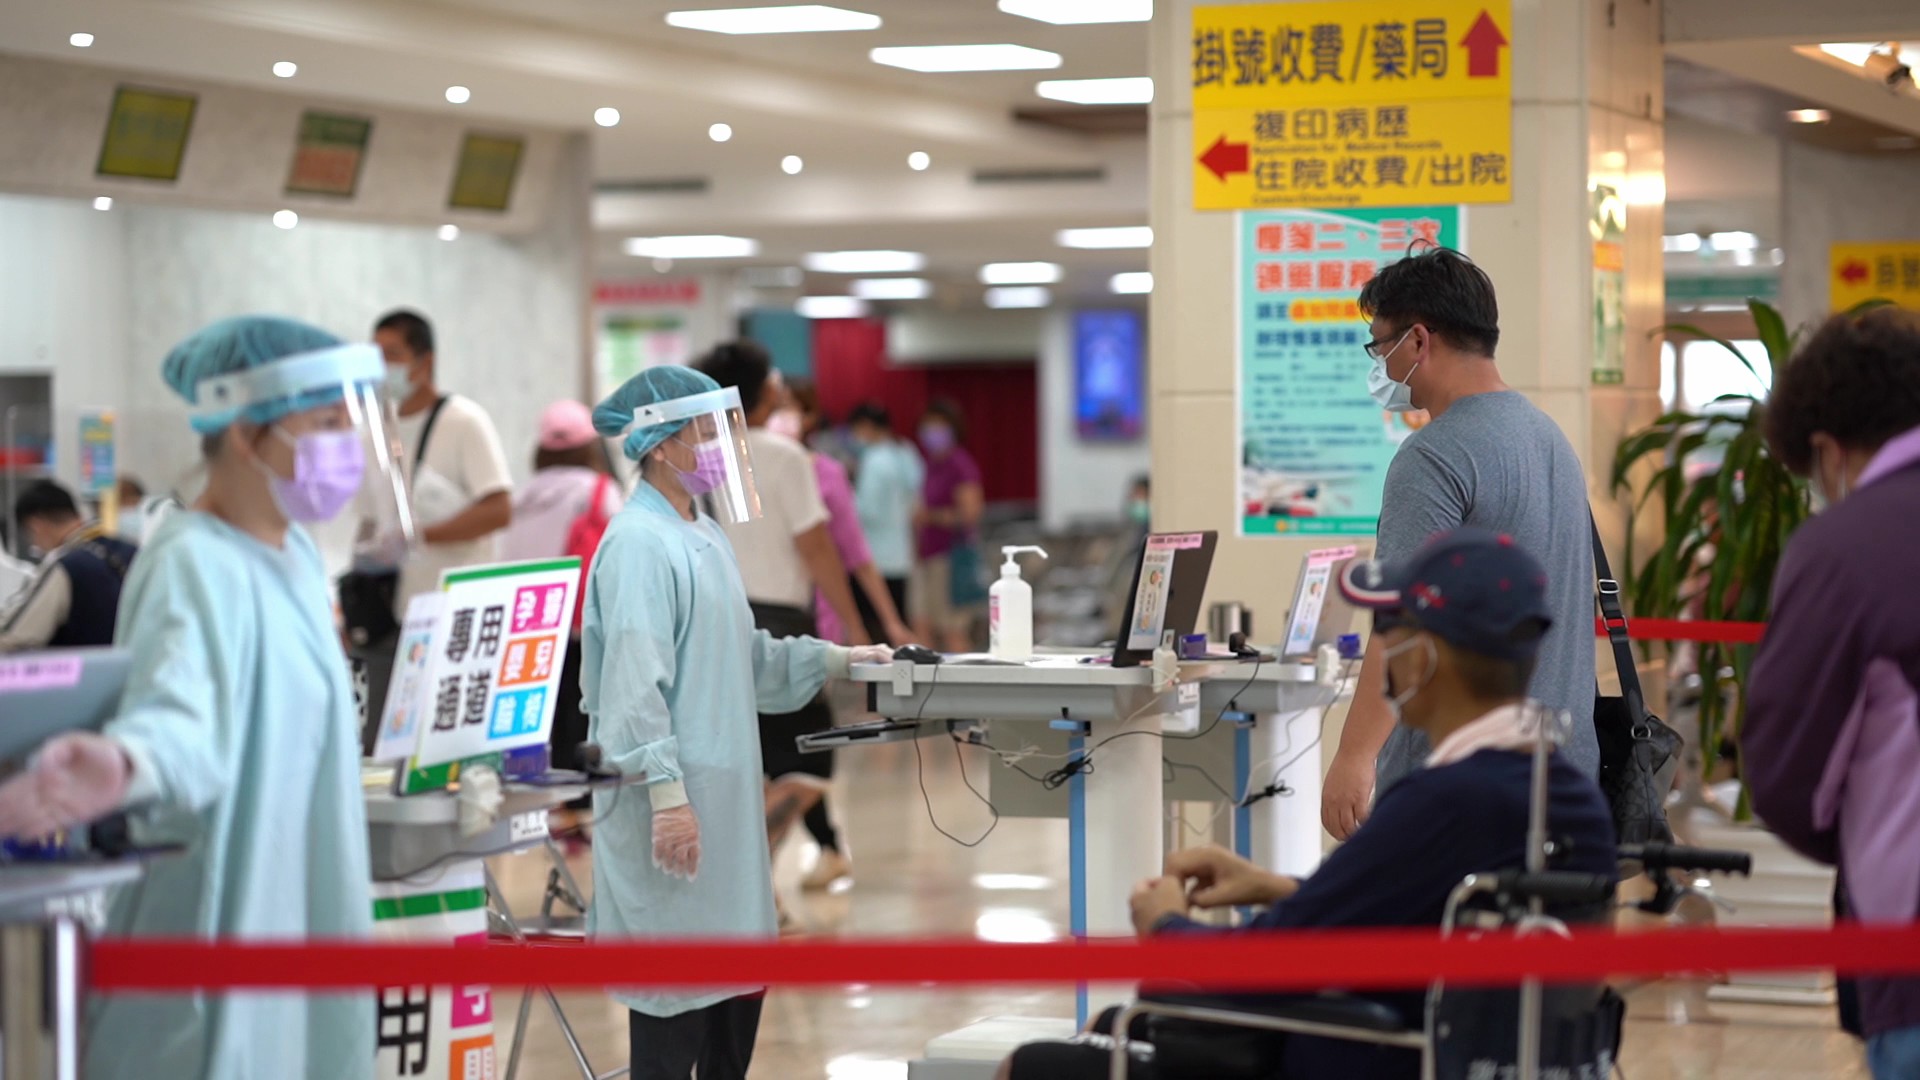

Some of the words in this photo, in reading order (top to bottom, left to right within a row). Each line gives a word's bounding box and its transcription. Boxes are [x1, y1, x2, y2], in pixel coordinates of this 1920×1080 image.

[1192, 18, 1449, 88] 掛號收費/藥局
[1253, 105, 1410, 142] 複印病歷
[1253, 153, 1507, 191] 住院收費/出院
[446, 604, 505, 663] 專用
